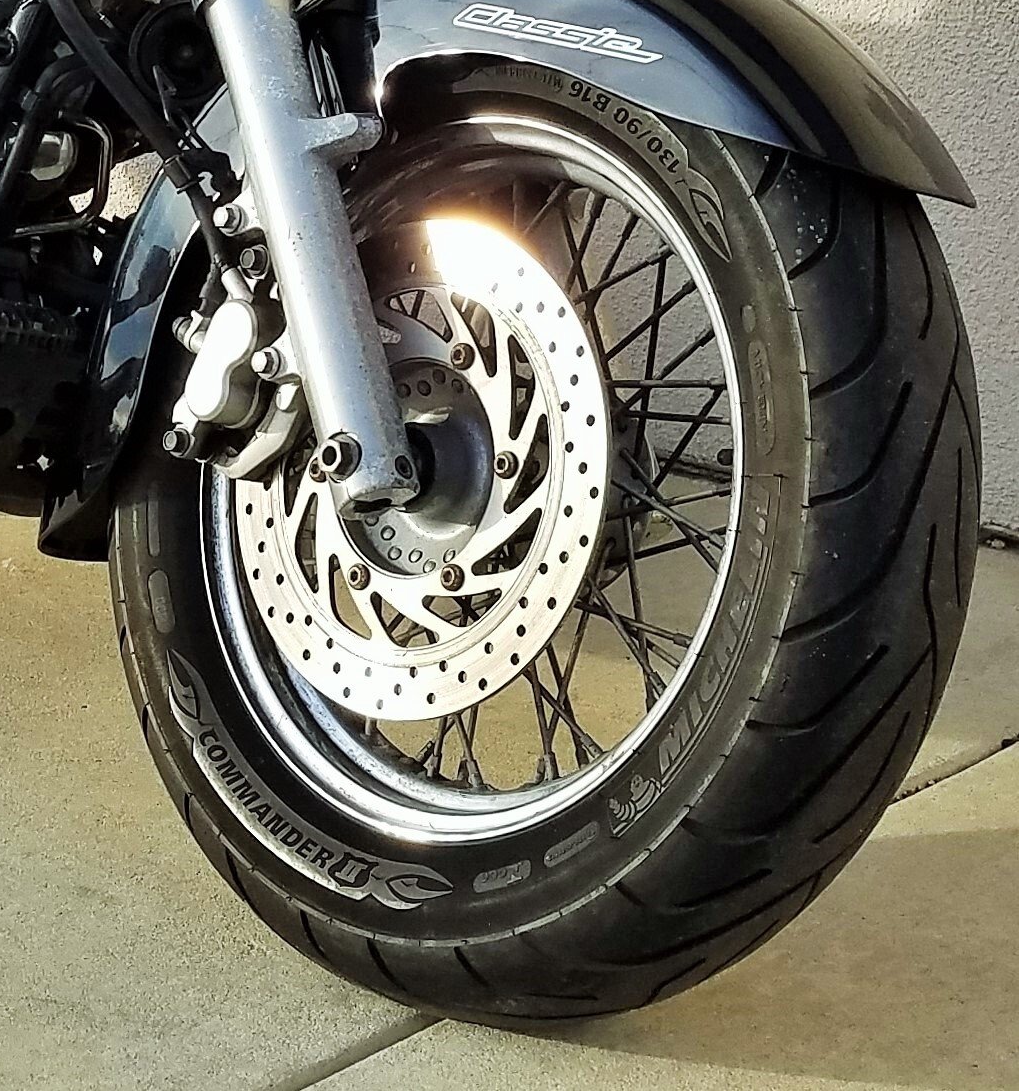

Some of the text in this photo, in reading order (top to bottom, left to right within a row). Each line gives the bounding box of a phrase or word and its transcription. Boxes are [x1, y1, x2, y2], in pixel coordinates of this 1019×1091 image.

[568, 79, 612, 110] B16
[612, 106, 680, 173] 130/90
[198, 728, 334, 868] COMMANDER
